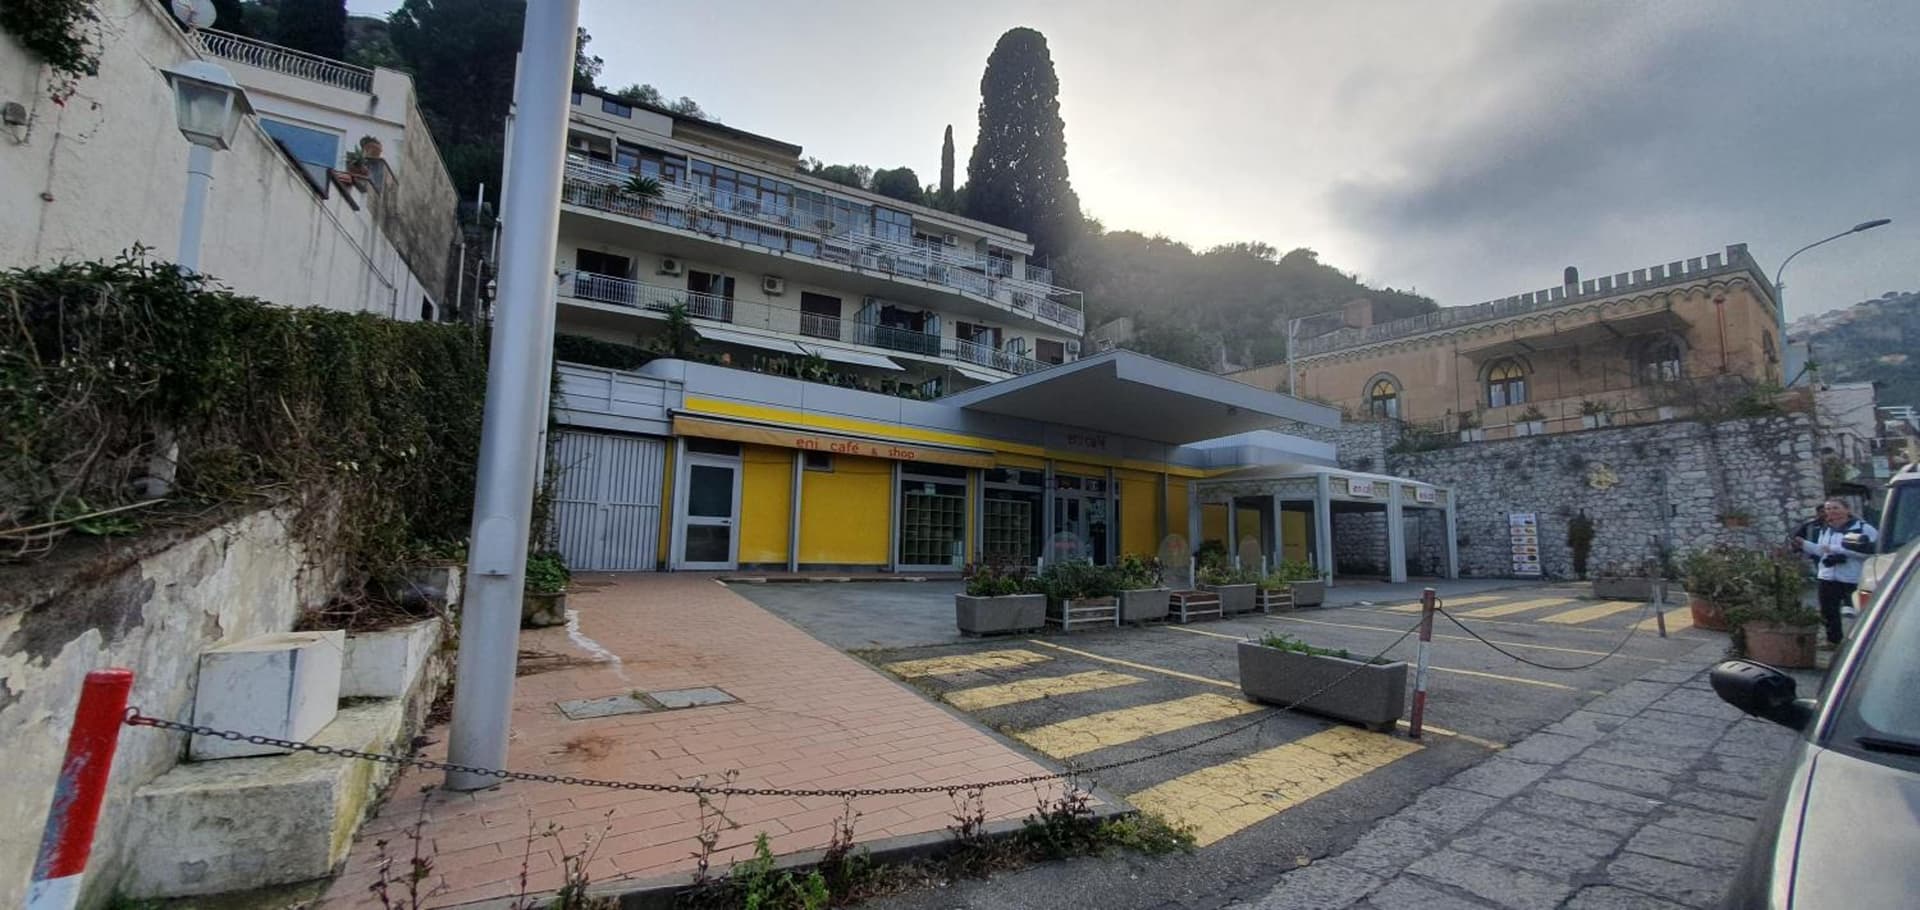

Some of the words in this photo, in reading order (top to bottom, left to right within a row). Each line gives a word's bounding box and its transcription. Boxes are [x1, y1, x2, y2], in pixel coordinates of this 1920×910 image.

[795, 437, 819, 449] eni
[830, 441, 859, 454] café
[888, 446, 915, 459] shop
